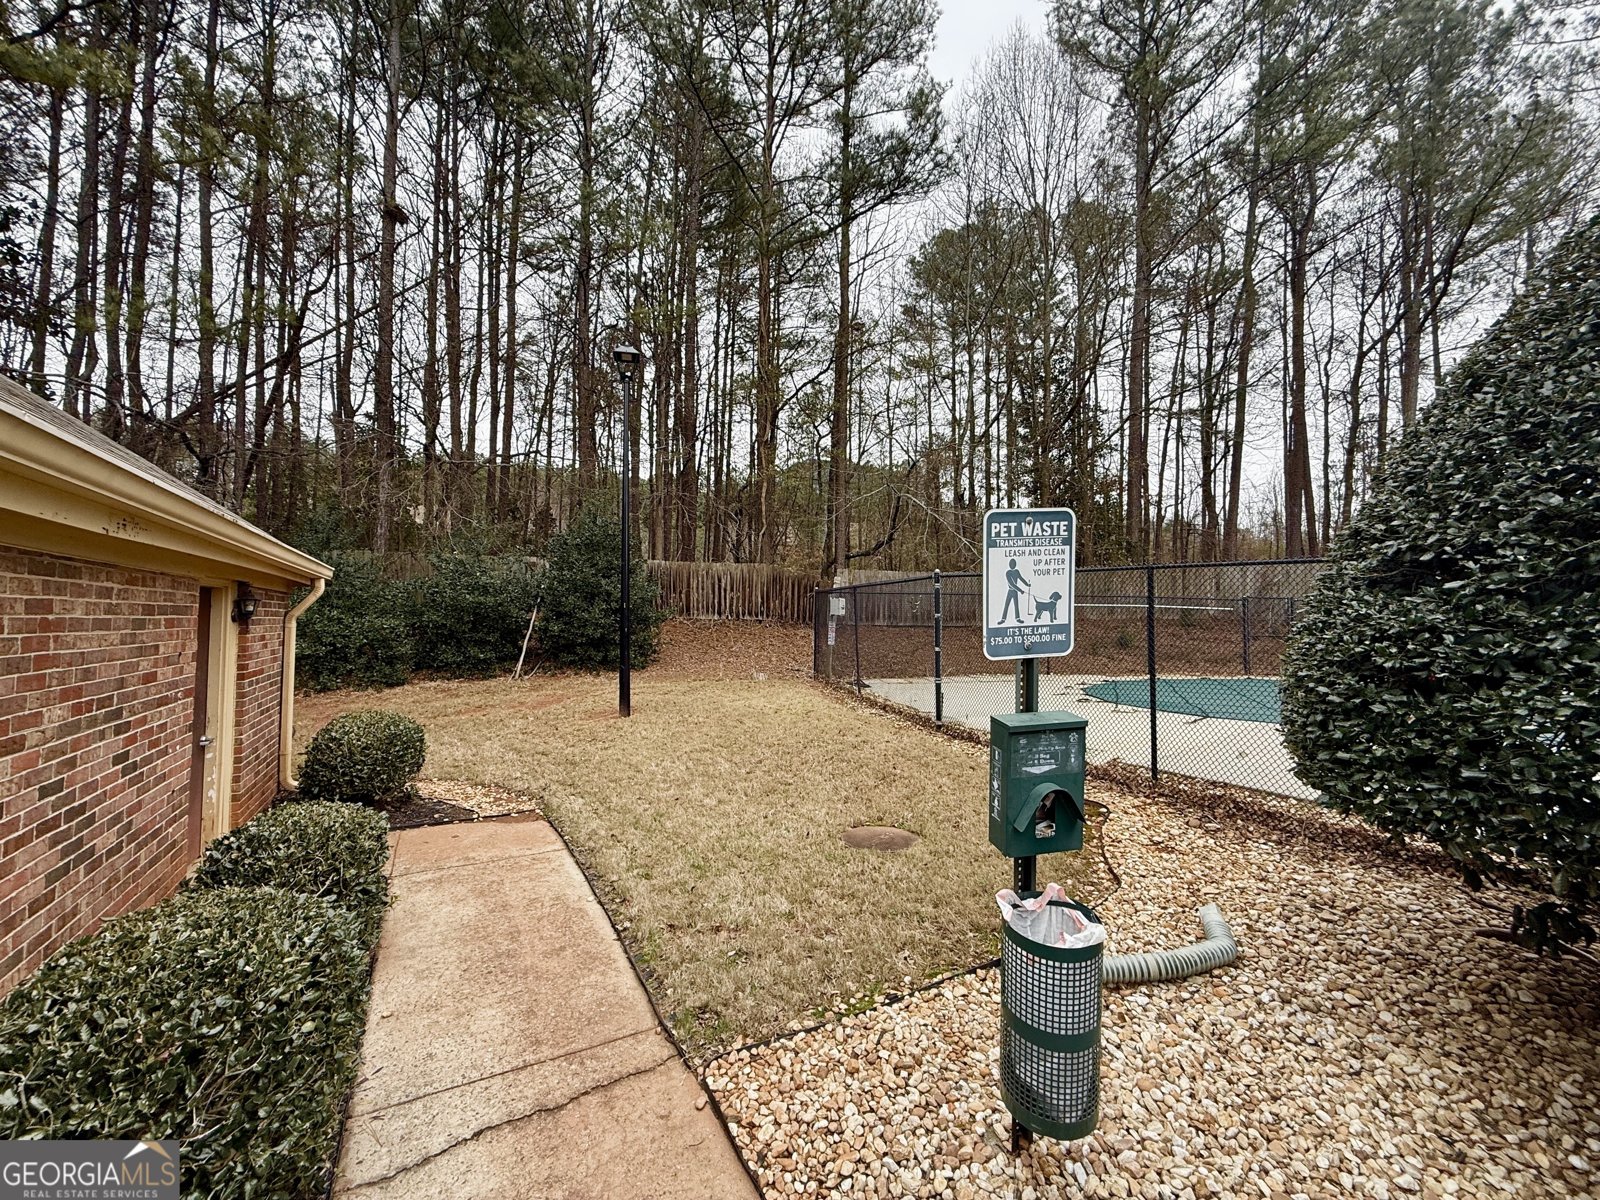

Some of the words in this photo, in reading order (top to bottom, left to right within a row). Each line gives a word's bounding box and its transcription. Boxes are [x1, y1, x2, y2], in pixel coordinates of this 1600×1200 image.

[991, 522, 1017, 537] PET
[1021, 521, 1068, 536] WASTE
[996, 538, 1034, 547] TRANSMITS
[1035, 538, 1063, 546] DISEASE
[1004, 549, 1026, 557] LEASH
[1028, 548, 1042, 556] AND
[1044, 548, 1066, 556] CLEAN
[1044, 558, 1066, 566] AFTER
[1053, 568, 1066, 576] PET
[1007, 628, 1019, 636] IT'S
[1021, 627, 1032, 635] THE
[1034, 626, 1049, 634] LAW!
[990, 636, 1012, 646] $75.00
[1023, 634, 1050, 644] $500.00
[1051, 633, 1066, 641] FINE
